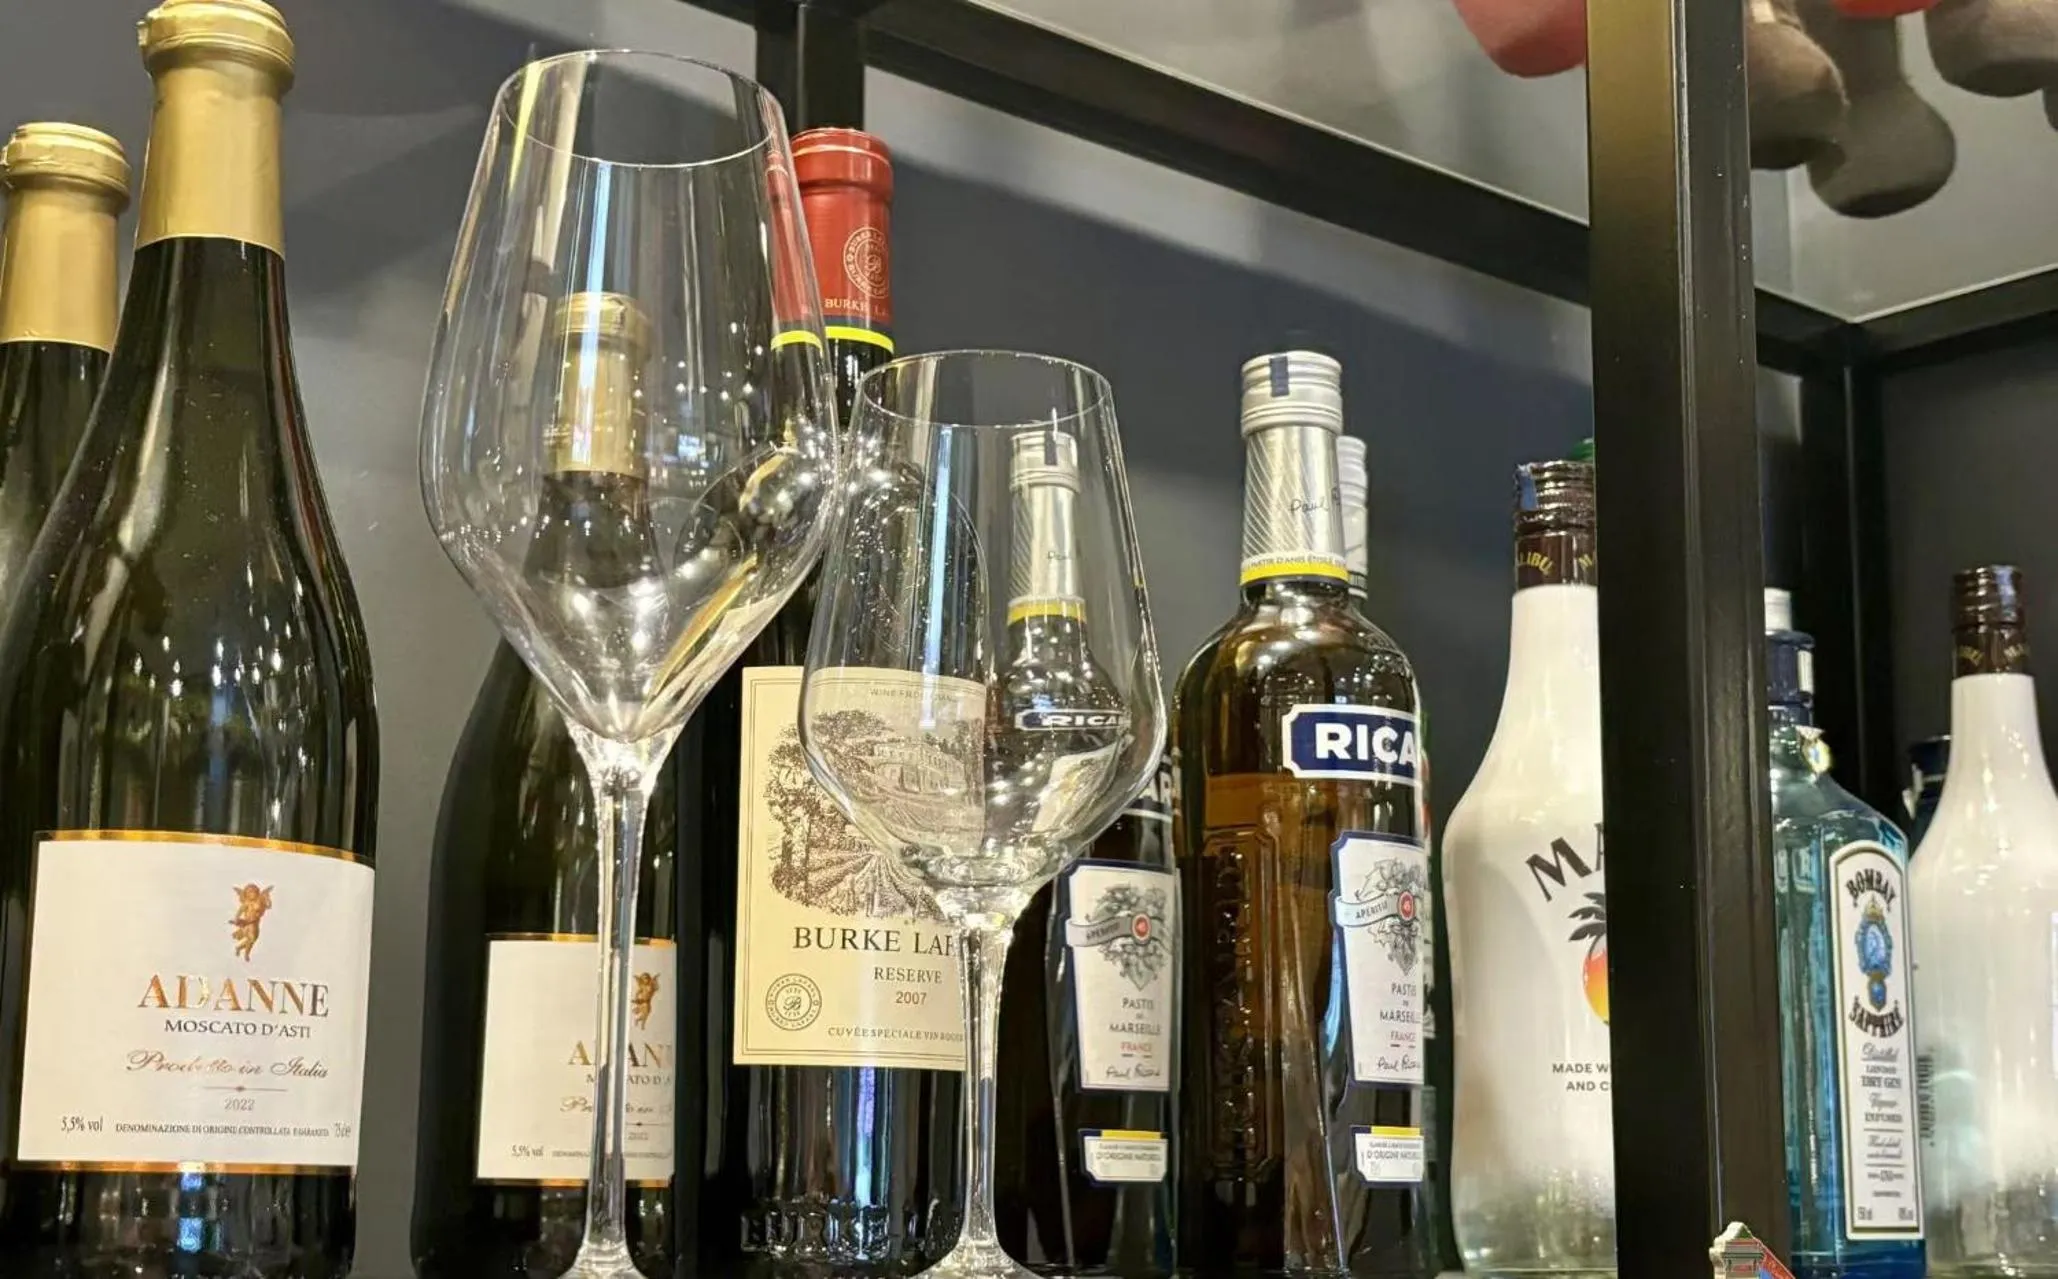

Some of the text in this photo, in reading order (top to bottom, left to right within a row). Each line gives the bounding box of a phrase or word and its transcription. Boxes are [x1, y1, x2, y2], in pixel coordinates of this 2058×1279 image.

[900, 689, 926, 698] FRO
[1315, 722, 1417, 769] RICA
[1845, 868, 1896, 912] BOMBAY
[793, 926, 901, 952] BURKE
[874, 966, 943, 984] RESERVE
[138, 974, 329, 1018] ADANNE
[895, 991, 927, 1006] 2007
[1848, 995, 1904, 1038] SAPPHIRE
[164, 1019, 311, 1039] MOSCATO D'ASTI
[827, 1025, 871, 1037] CUVÉE
[238, 1062, 263, 1075] in
[270, 1056, 329, 1079] Italia
[1552, 1063, 1592, 1074] MADE
[1566, 1080, 1596, 1092] AND
[224, 1099, 255, 1112] 2022
[61, 1116, 104, 1133] 5,5% vol
[115, 1123, 190, 1133] DENOMINAZIONE
